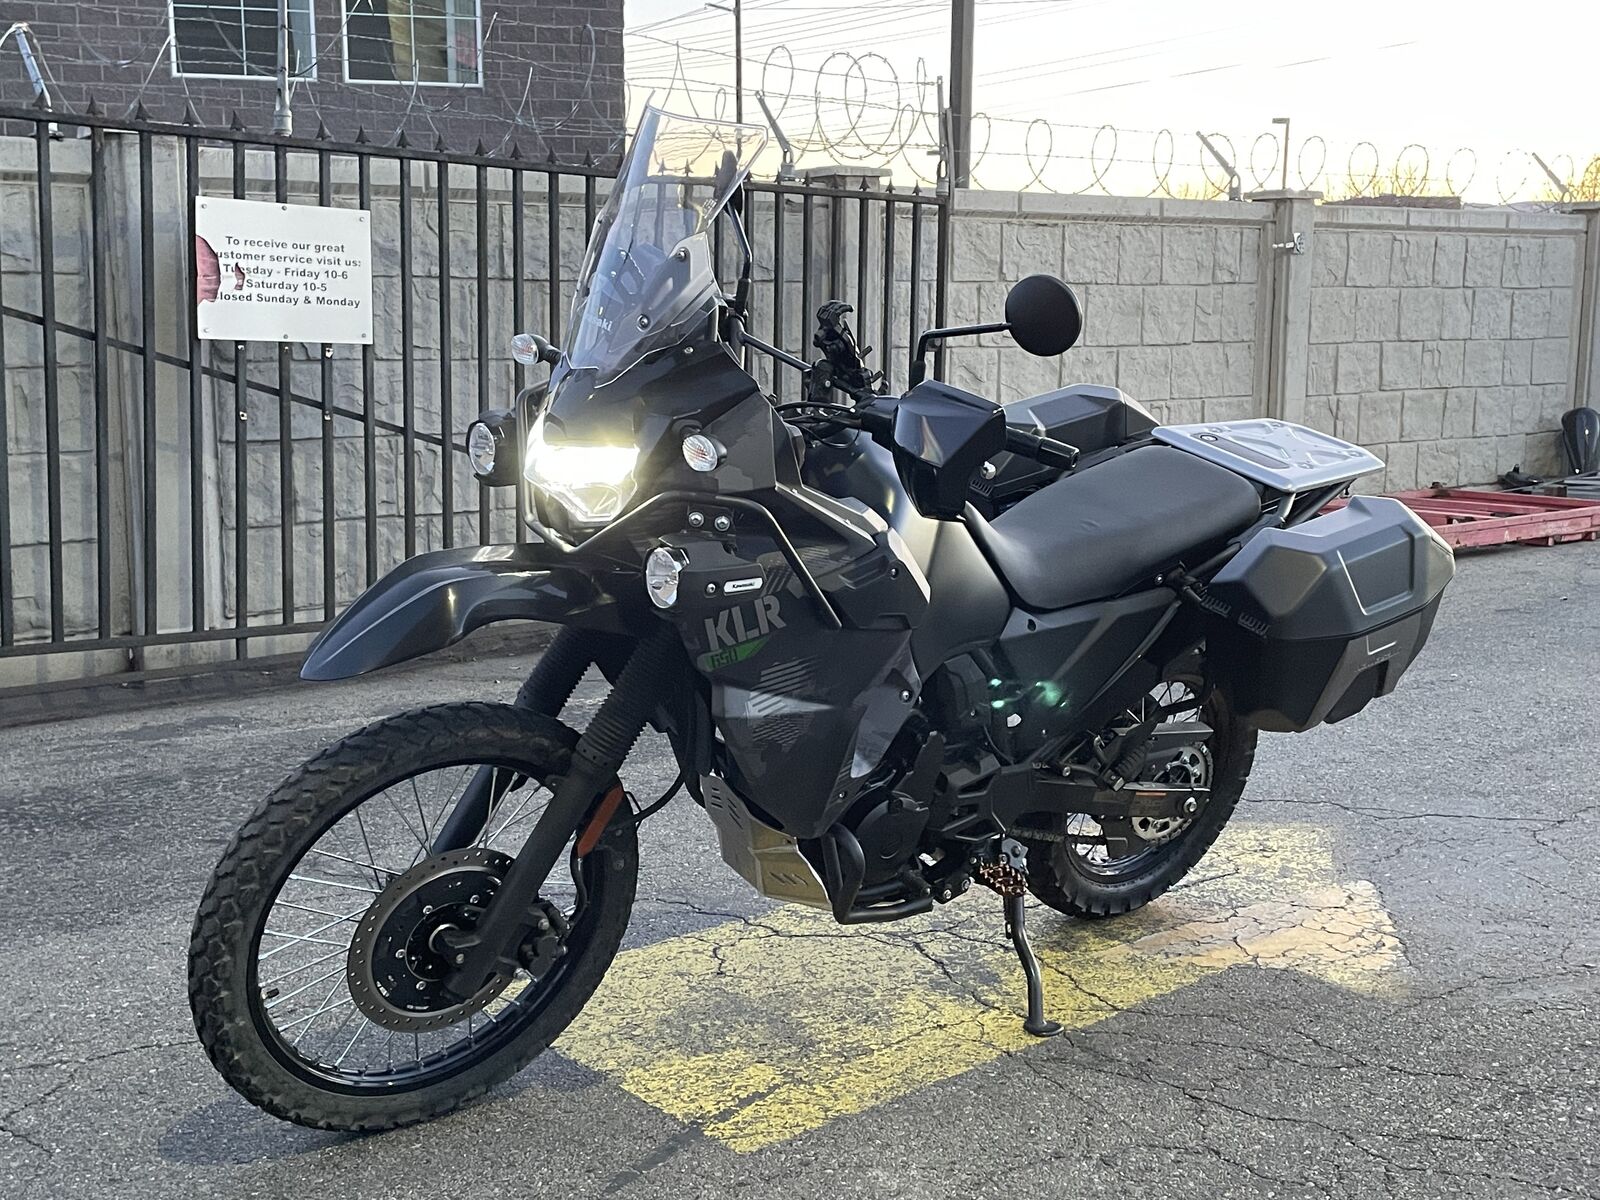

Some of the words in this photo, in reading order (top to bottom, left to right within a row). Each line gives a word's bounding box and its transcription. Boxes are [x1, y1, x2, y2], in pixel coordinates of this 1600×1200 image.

[225, 235, 240, 246] To
[244, 239, 288, 249] receive
[292, 242, 311, 251] our
[314, 244, 345, 254] great
[216, 250, 266, 261] ustomer
[269, 254, 313, 264] service
[316, 256, 341, 266] visit
[345, 259, 361, 268] us:
[284, 267, 320, 280] Friday
[324, 270, 349, 280] 10-6
[246, 278, 299, 293] Saturday
[303, 282, 328, 292] 10-5
[217, 291, 253, 302] losed
[256, 293, 299, 306] Sunday
[303, 295, 312, 305] &
[316, 296, 361, 309] Monday
[704, 595, 786, 651] KLR
